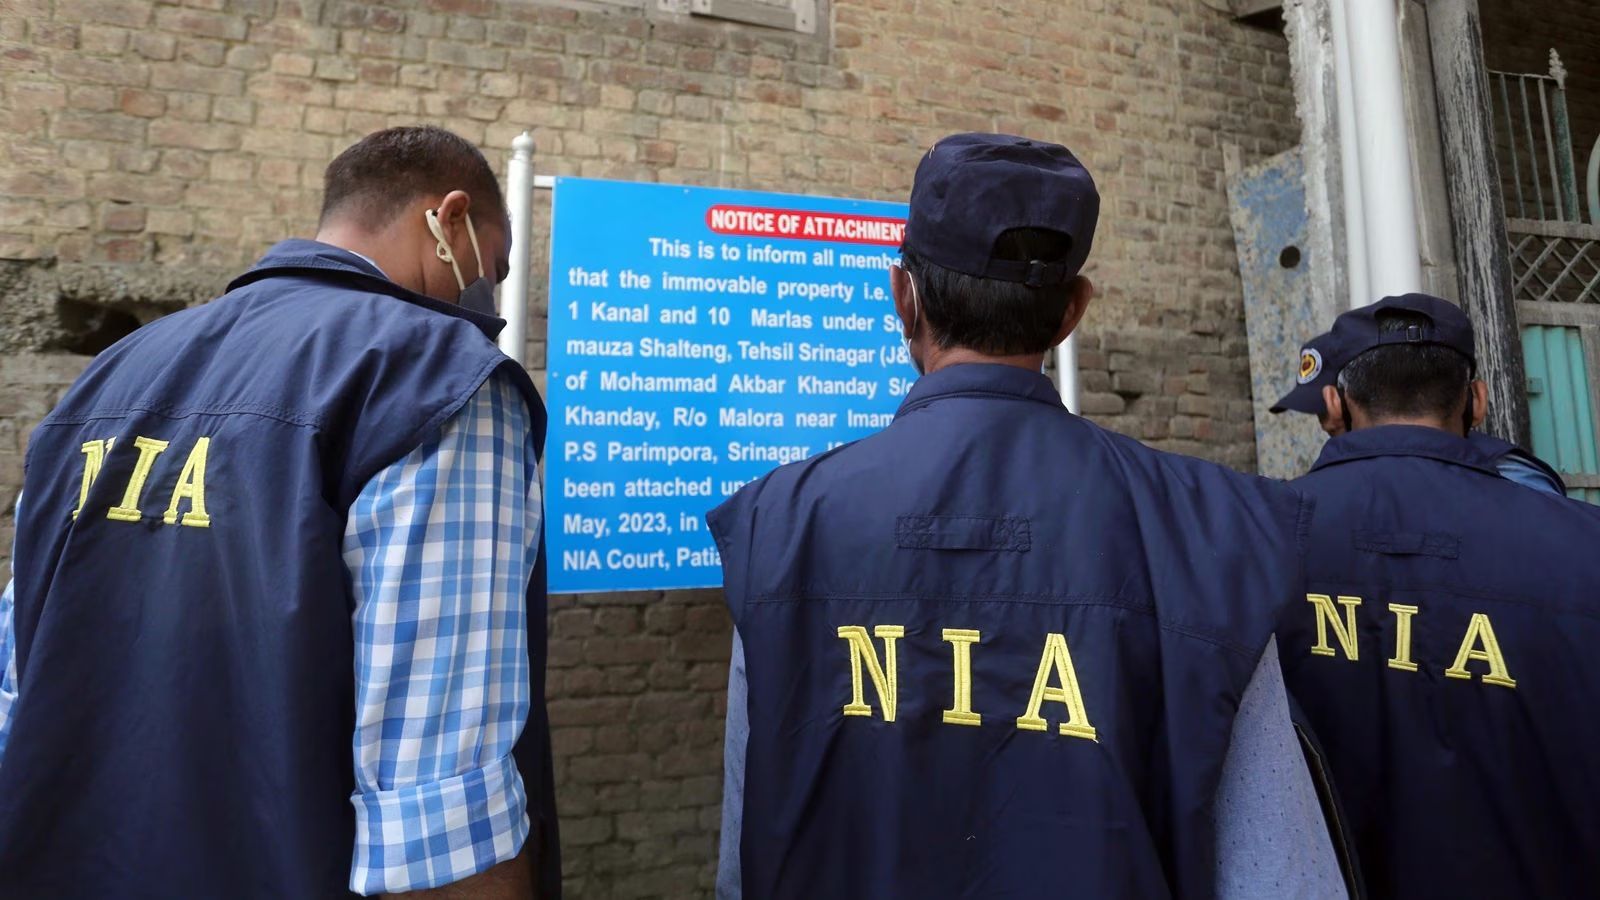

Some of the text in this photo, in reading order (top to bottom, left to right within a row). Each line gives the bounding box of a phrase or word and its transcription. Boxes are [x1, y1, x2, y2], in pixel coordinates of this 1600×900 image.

[711, 208, 775, 233] NOTICE
[778, 214, 800, 234] OF
[649, 237, 691, 258] This
[698, 241, 715, 259] is
[721, 244, 740, 260] to
[747, 243, 807, 264] inform
[813, 249, 833, 266] all
[568, 267, 889, 303] that the immovable property i.e.
[569, 301, 578, 320] 1
[592, 302, 649, 322] Kanal
[660, 306, 696, 324] and
[709, 307, 730, 325] 10
[752, 309, 812, 328] Marlas
[823, 314, 874, 330] under
[567, 340, 633, 356] mauza
[640, 338, 731, 363] Shalteng,
[738, 341, 793, 360] Tehsil
[799, 343, 875, 367] Srinagar
[566, 371, 587, 390] of
[601, 371, 717, 392] Mohammad
[729, 374, 786, 393] Akbar
[798, 376, 877, 400] Khanday
[566, 406, 660, 430] Khanday,
[674, 407, 706, 426] R/o
[720, 408, 784, 427] Malora
[796, 413, 837, 427] near
[565, 441, 596, 461] P.S
[608, 442, 717, 465] Parimpora,
[728, 442, 811, 465] Srinagar
[72, 436, 211, 528] NIA
[564, 477, 757, 497] been attached un
[564, 514, 610, 536] May,
[619, 513, 672, 534] 2023,
[681, 513, 697, 530] in
[564, 550, 600, 569] NIA
[607, 549, 670, 571] Court,
[1306, 593, 1517, 688] NIA
[837, 624, 1097, 740] NIA
